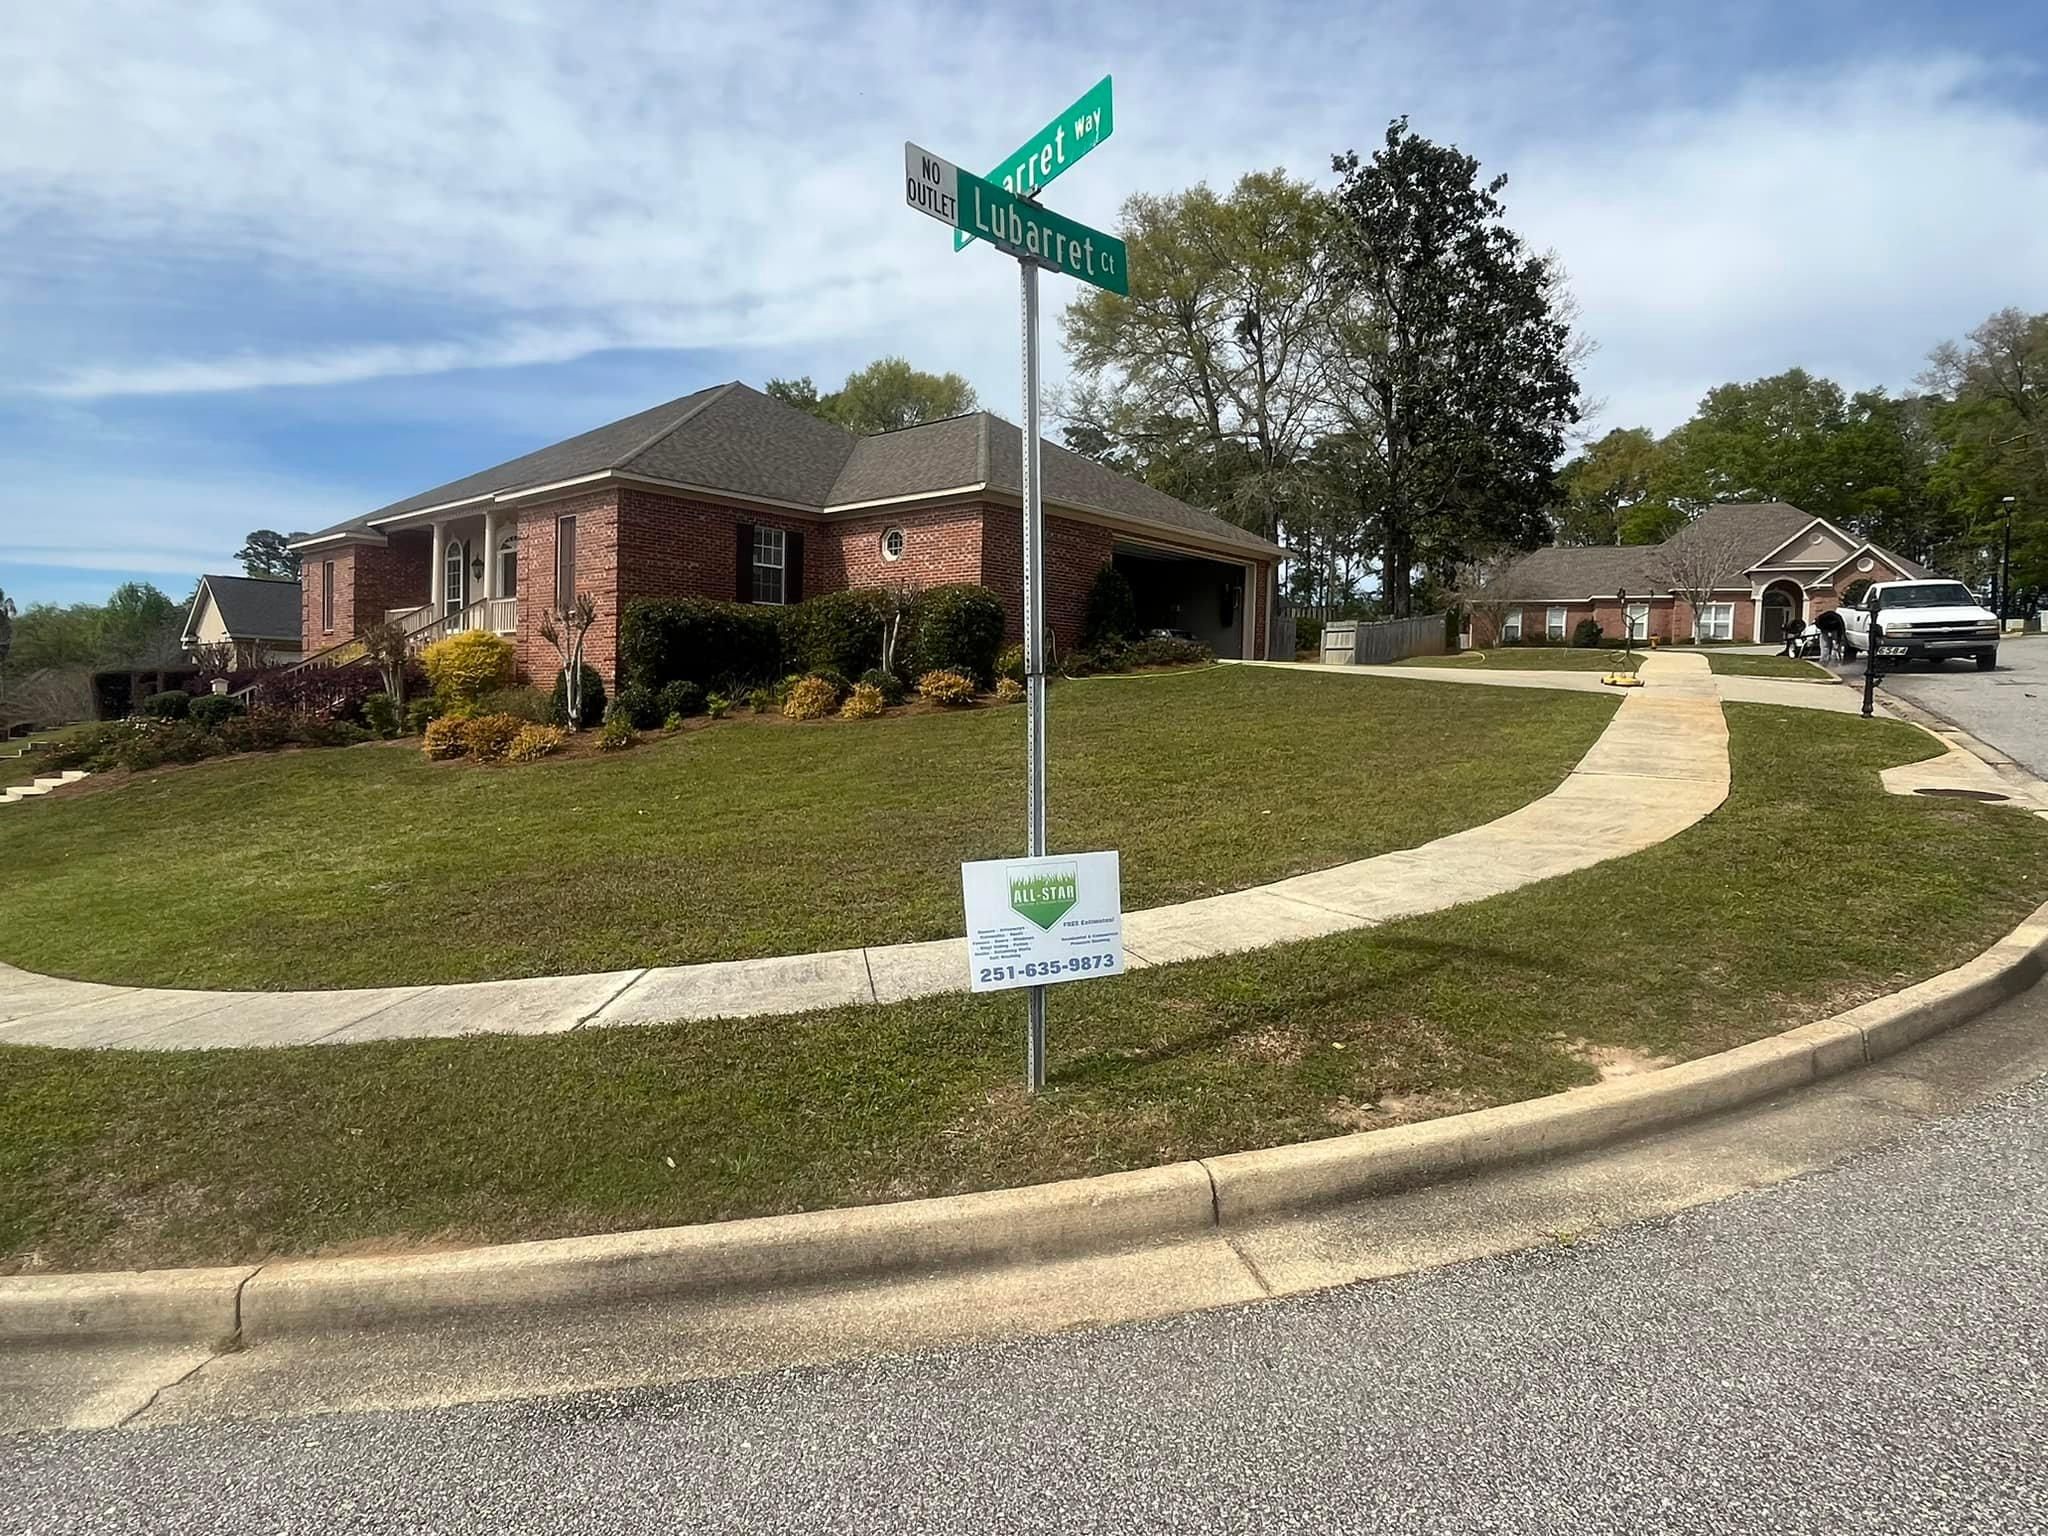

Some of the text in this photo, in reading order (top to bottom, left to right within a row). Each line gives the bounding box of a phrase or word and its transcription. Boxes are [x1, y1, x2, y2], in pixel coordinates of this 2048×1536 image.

[1074, 107, 1102, 139] Way
[922, 156, 941, 185] NO
[907, 177, 956, 220] OUTLET
[974, 186, 1115, 276] Lubarret Ct
[1013, 885, 1075, 903] ALL-STAR
[980, 954, 1115, 983] 251-635-9873
